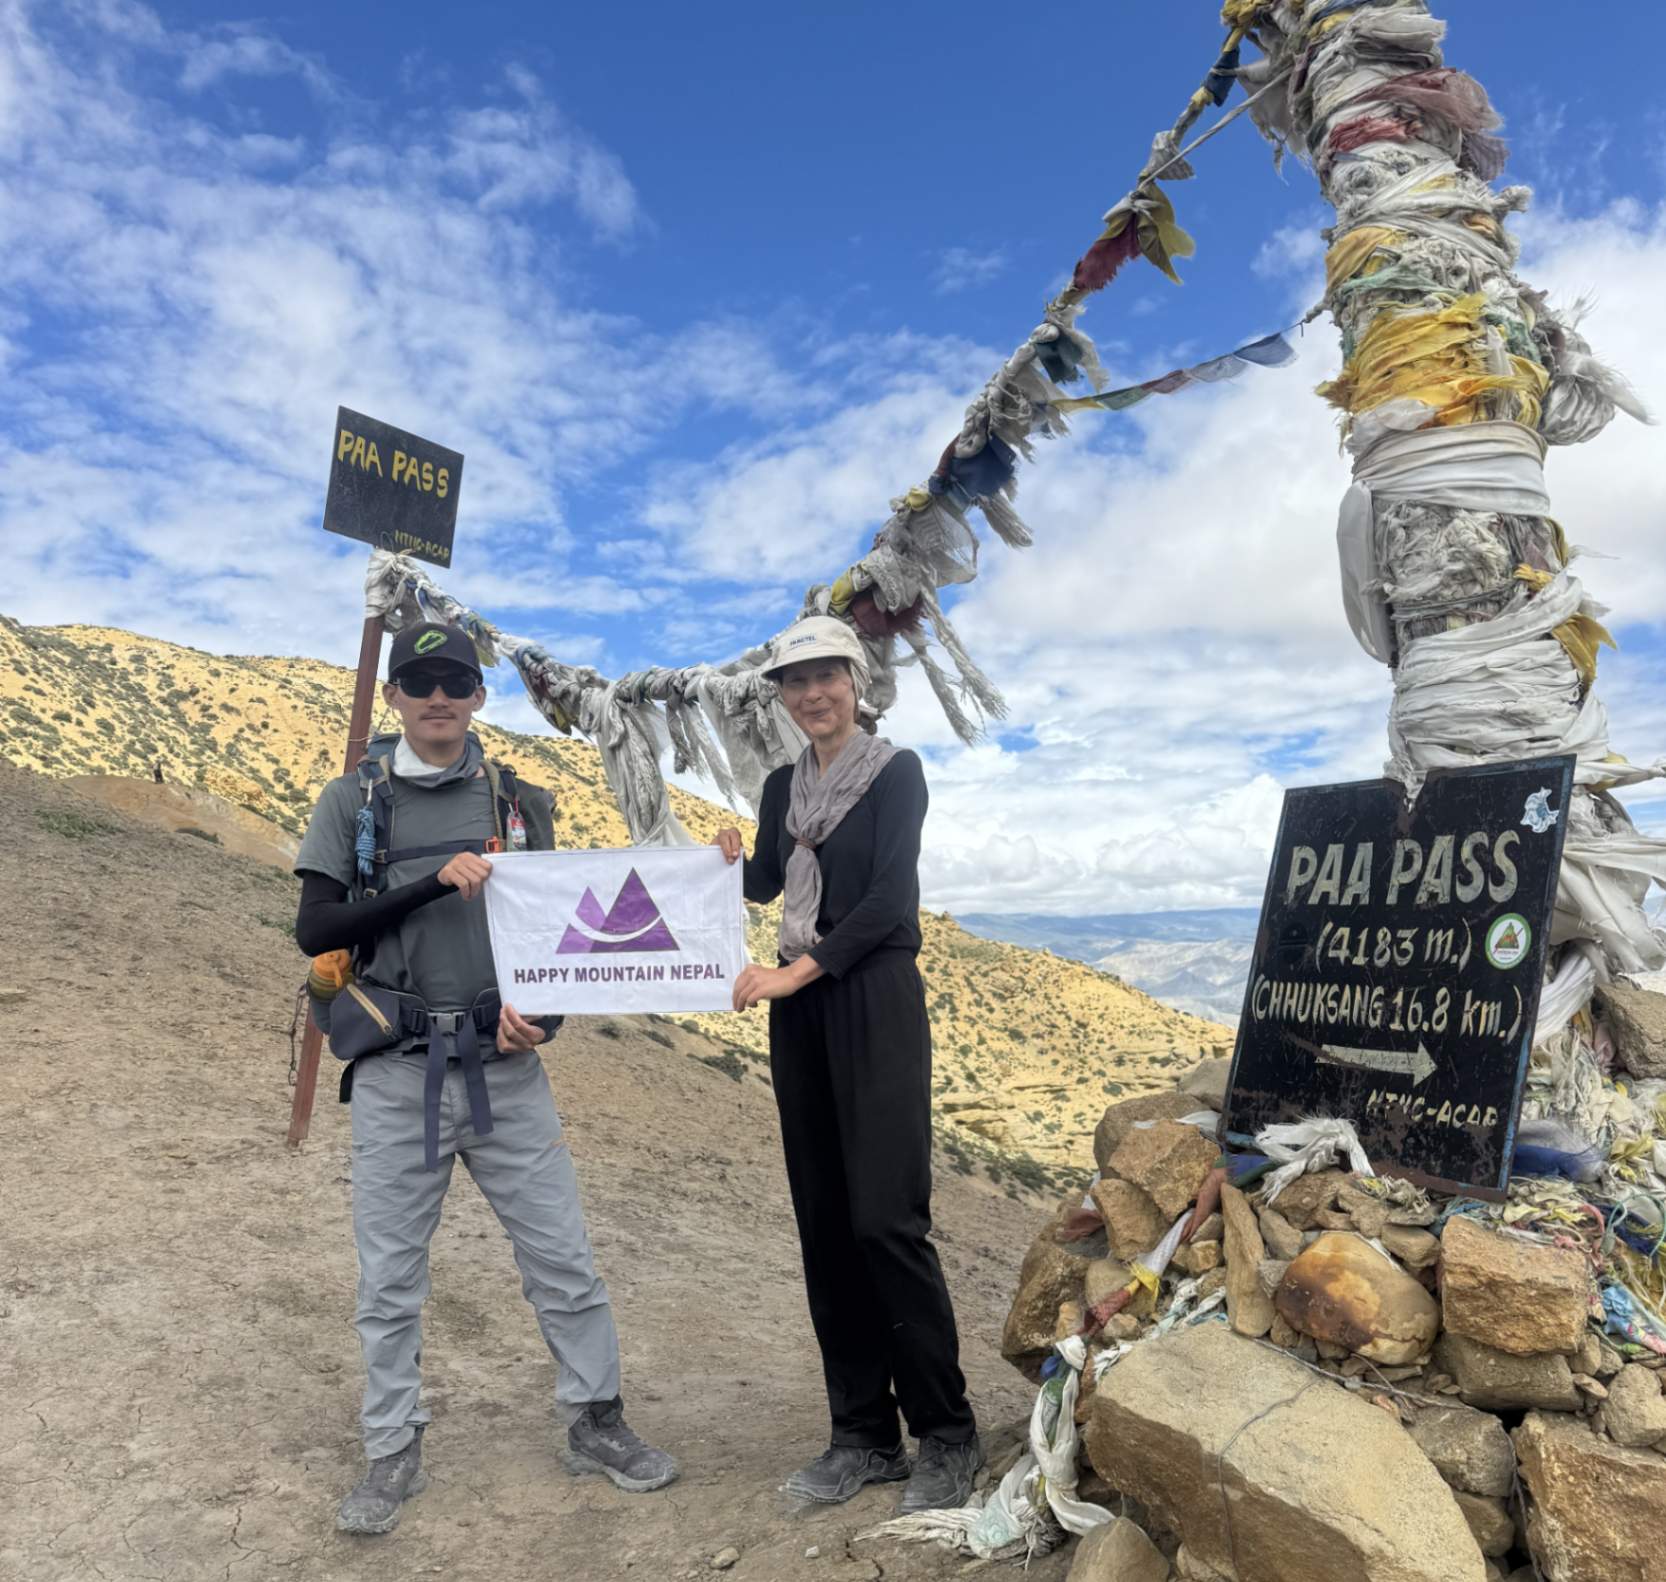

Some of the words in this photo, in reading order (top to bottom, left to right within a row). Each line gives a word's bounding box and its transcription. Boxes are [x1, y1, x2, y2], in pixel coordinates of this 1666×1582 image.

[337, 429, 383, 478] PAA
[391, 450, 449, 498] PASS
[1284, 843, 1374, 906] PAA
[1385, 829, 1521, 905] PASS
[514, 968, 570, 984] HAPPY
[574, 965, 665, 982] MOUNTAIN
[669, 963, 726, 980] NEPAL
[1315, 920, 1419, 974] (4183
[1424, 916, 1472, 974] m.)
[1252, 973, 1386, 1029] (CHHUKSANG
[1389, 986, 1450, 1032] 16.8
[1459, 984, 1522, 1044] km.)
